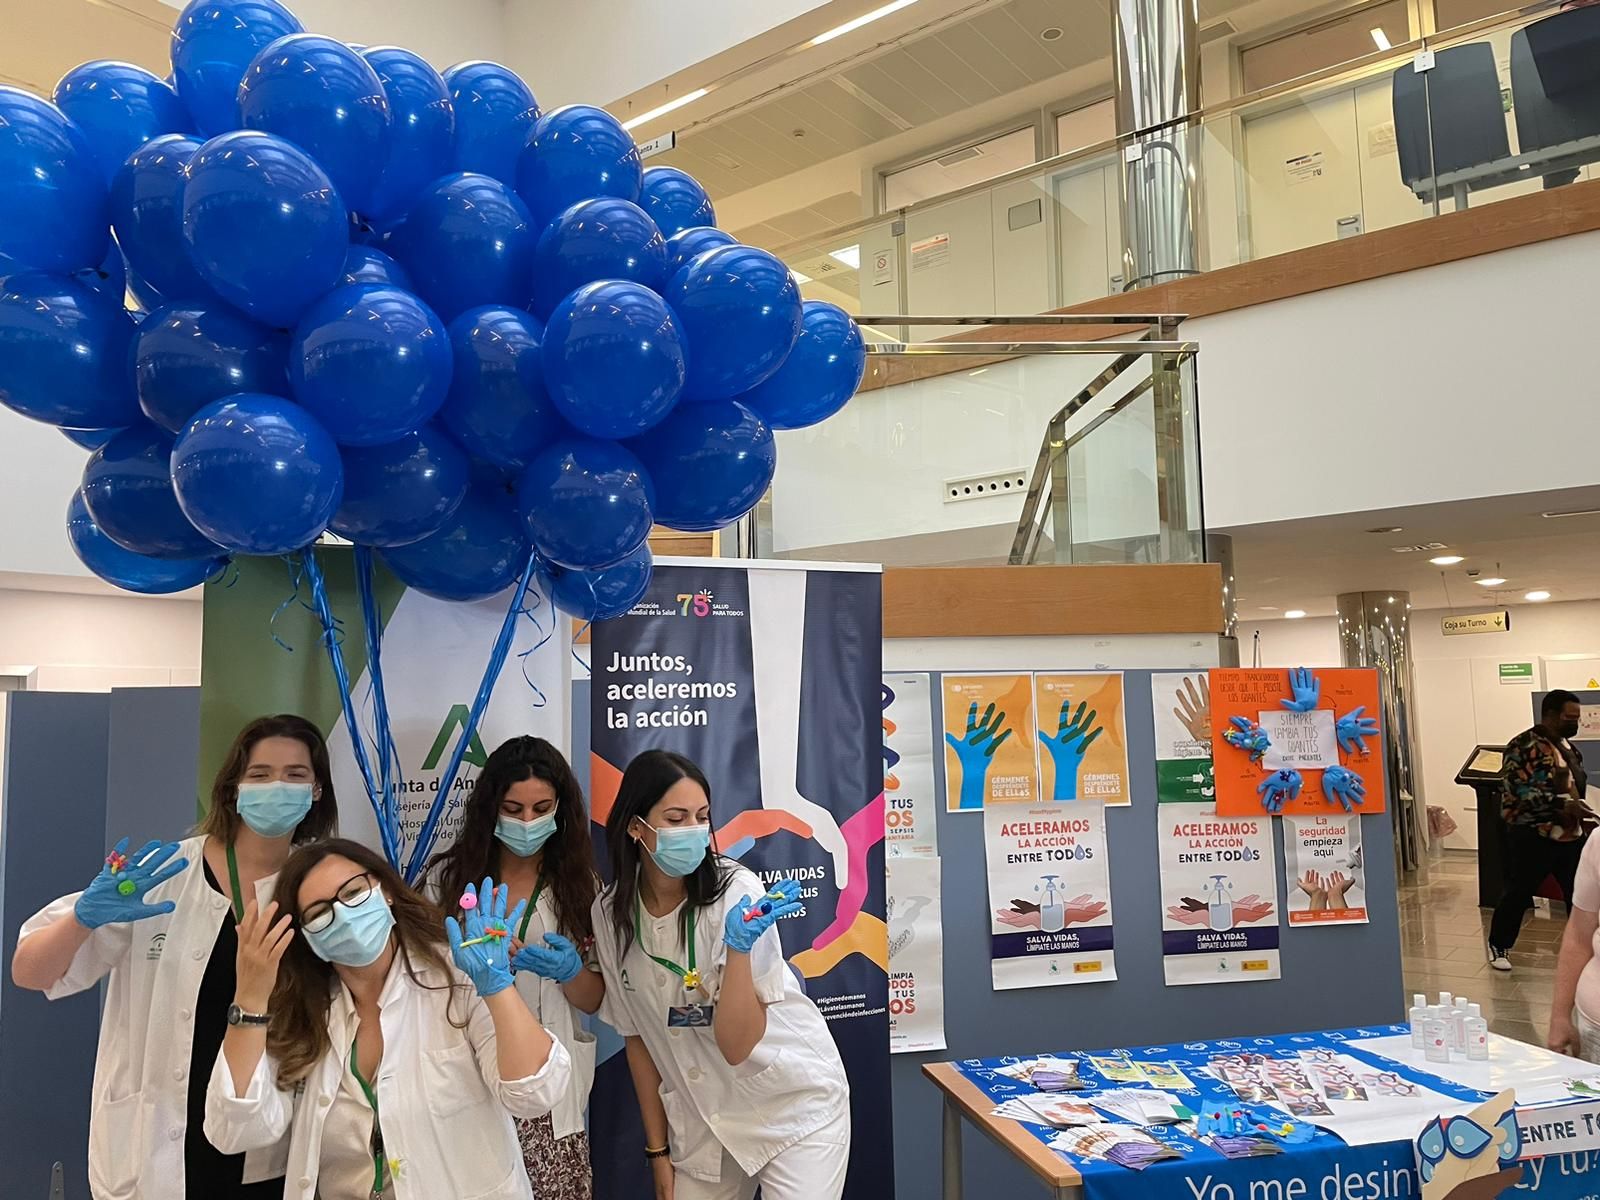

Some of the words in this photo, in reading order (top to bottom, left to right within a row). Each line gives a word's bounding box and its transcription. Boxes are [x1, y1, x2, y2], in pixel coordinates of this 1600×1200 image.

[640, 145, 653, 154] anta
[676, 593, 710, 617] 75
[662, 608, 676, 616] Salud
[1444, 621, 1458, 630] Coja
[1468, 619, 1487, 627] Turno
[606, 652, 693, 676] Juntos,
[607, 678, 737, 700] aceleremos
[607, 707, 628, 729] la
[635, 704, 708, 728] acción
[1280, 713, 1314, 726] SIEMPRE
[1303, 726, 1319, 739] TUS
[1287, 739, 1319, 754] GUANTES
[1083, 773, 1120, 781] GÉRMENES
[992, 789, 1004, 797] DE
[1085, 786, 1096, 794] DE
[890, 799, 914, 809] TUS
[886, 810, 914, 828] OS
[1316, 816, 1327, 825] La
[1001, 819, 1090, 837] ACELERAMOS
[1173, 822, 1258, 837] ACELERAMOS
[1299, 826, 1346, 837] seguridad
[1018, 839, 1031, 848] LA
[1034, 834, 1075, 848] ACCIÓN
[1189, 840, 1202, 848] LA
[1205, 836, 1243, 848] ACCIÓN
[1303, 837, 1343, 846] empieza
[1007, 852, 1043, 864] ENTRE
[1179, 853, 1213, 863] ENTRE
[1313, 847, 1334, 857] aquí
[758, 871, 784, 884] LVA
[785, 866, 825, 882] VIDAS
[1026, 935, 1052, 944] SALVA
[1053, 933, 1080, 942] VIDAS,
[1197, 934, 1222, 942] SALVA
[1050, 942, 1061, 950] LAS
[1061, 941, 1080, 949] MANOS
[817, 994, 866, 1004] #Higienedemanos
[895, 990, 915, 998] TUS
[889, 998, 916, 1015] OS
[823, 1007, 886, 1020] revencióndeinfecciones
[1519, 1120, 1577, 1144] ENTRE
[1185, 1175, 1234, 1200] Yo
[1250, 1177, 1306, 1200] me
